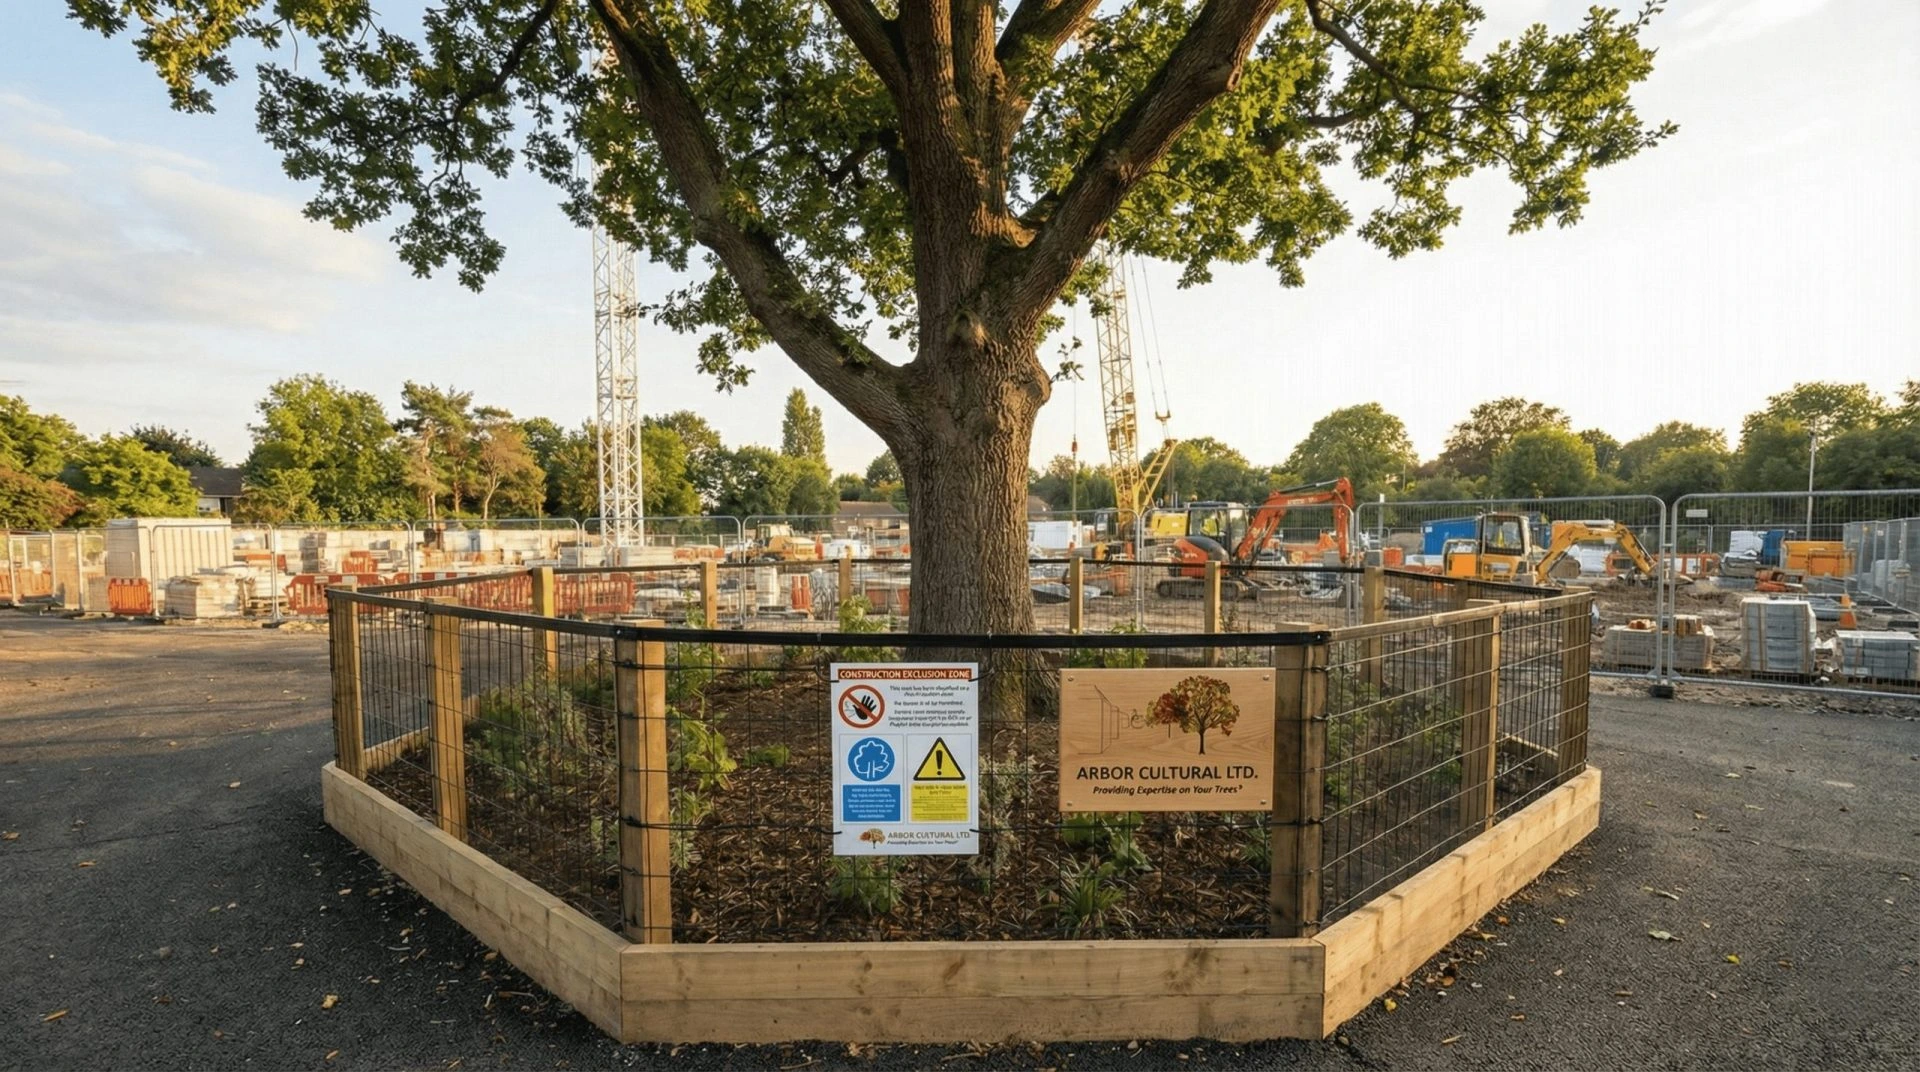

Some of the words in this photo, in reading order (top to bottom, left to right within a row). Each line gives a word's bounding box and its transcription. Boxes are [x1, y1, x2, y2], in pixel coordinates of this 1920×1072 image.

[840, 670, 901, 679] CONSTRUCTION
[903, 670, 946, 679] EXCLUSION
[948, 670, 970, 679] ZONE
[1076, 766, 1135, 780] ARBOR
[1139, 766, 1222, 780] CULTURAL
[1227, 765, 1259, 779] LTD.
[1093, 786, 1135, 796] Providing
[1137, 786, 1177, 796] Expertise
[1193, 786, 1213, 794] Your
